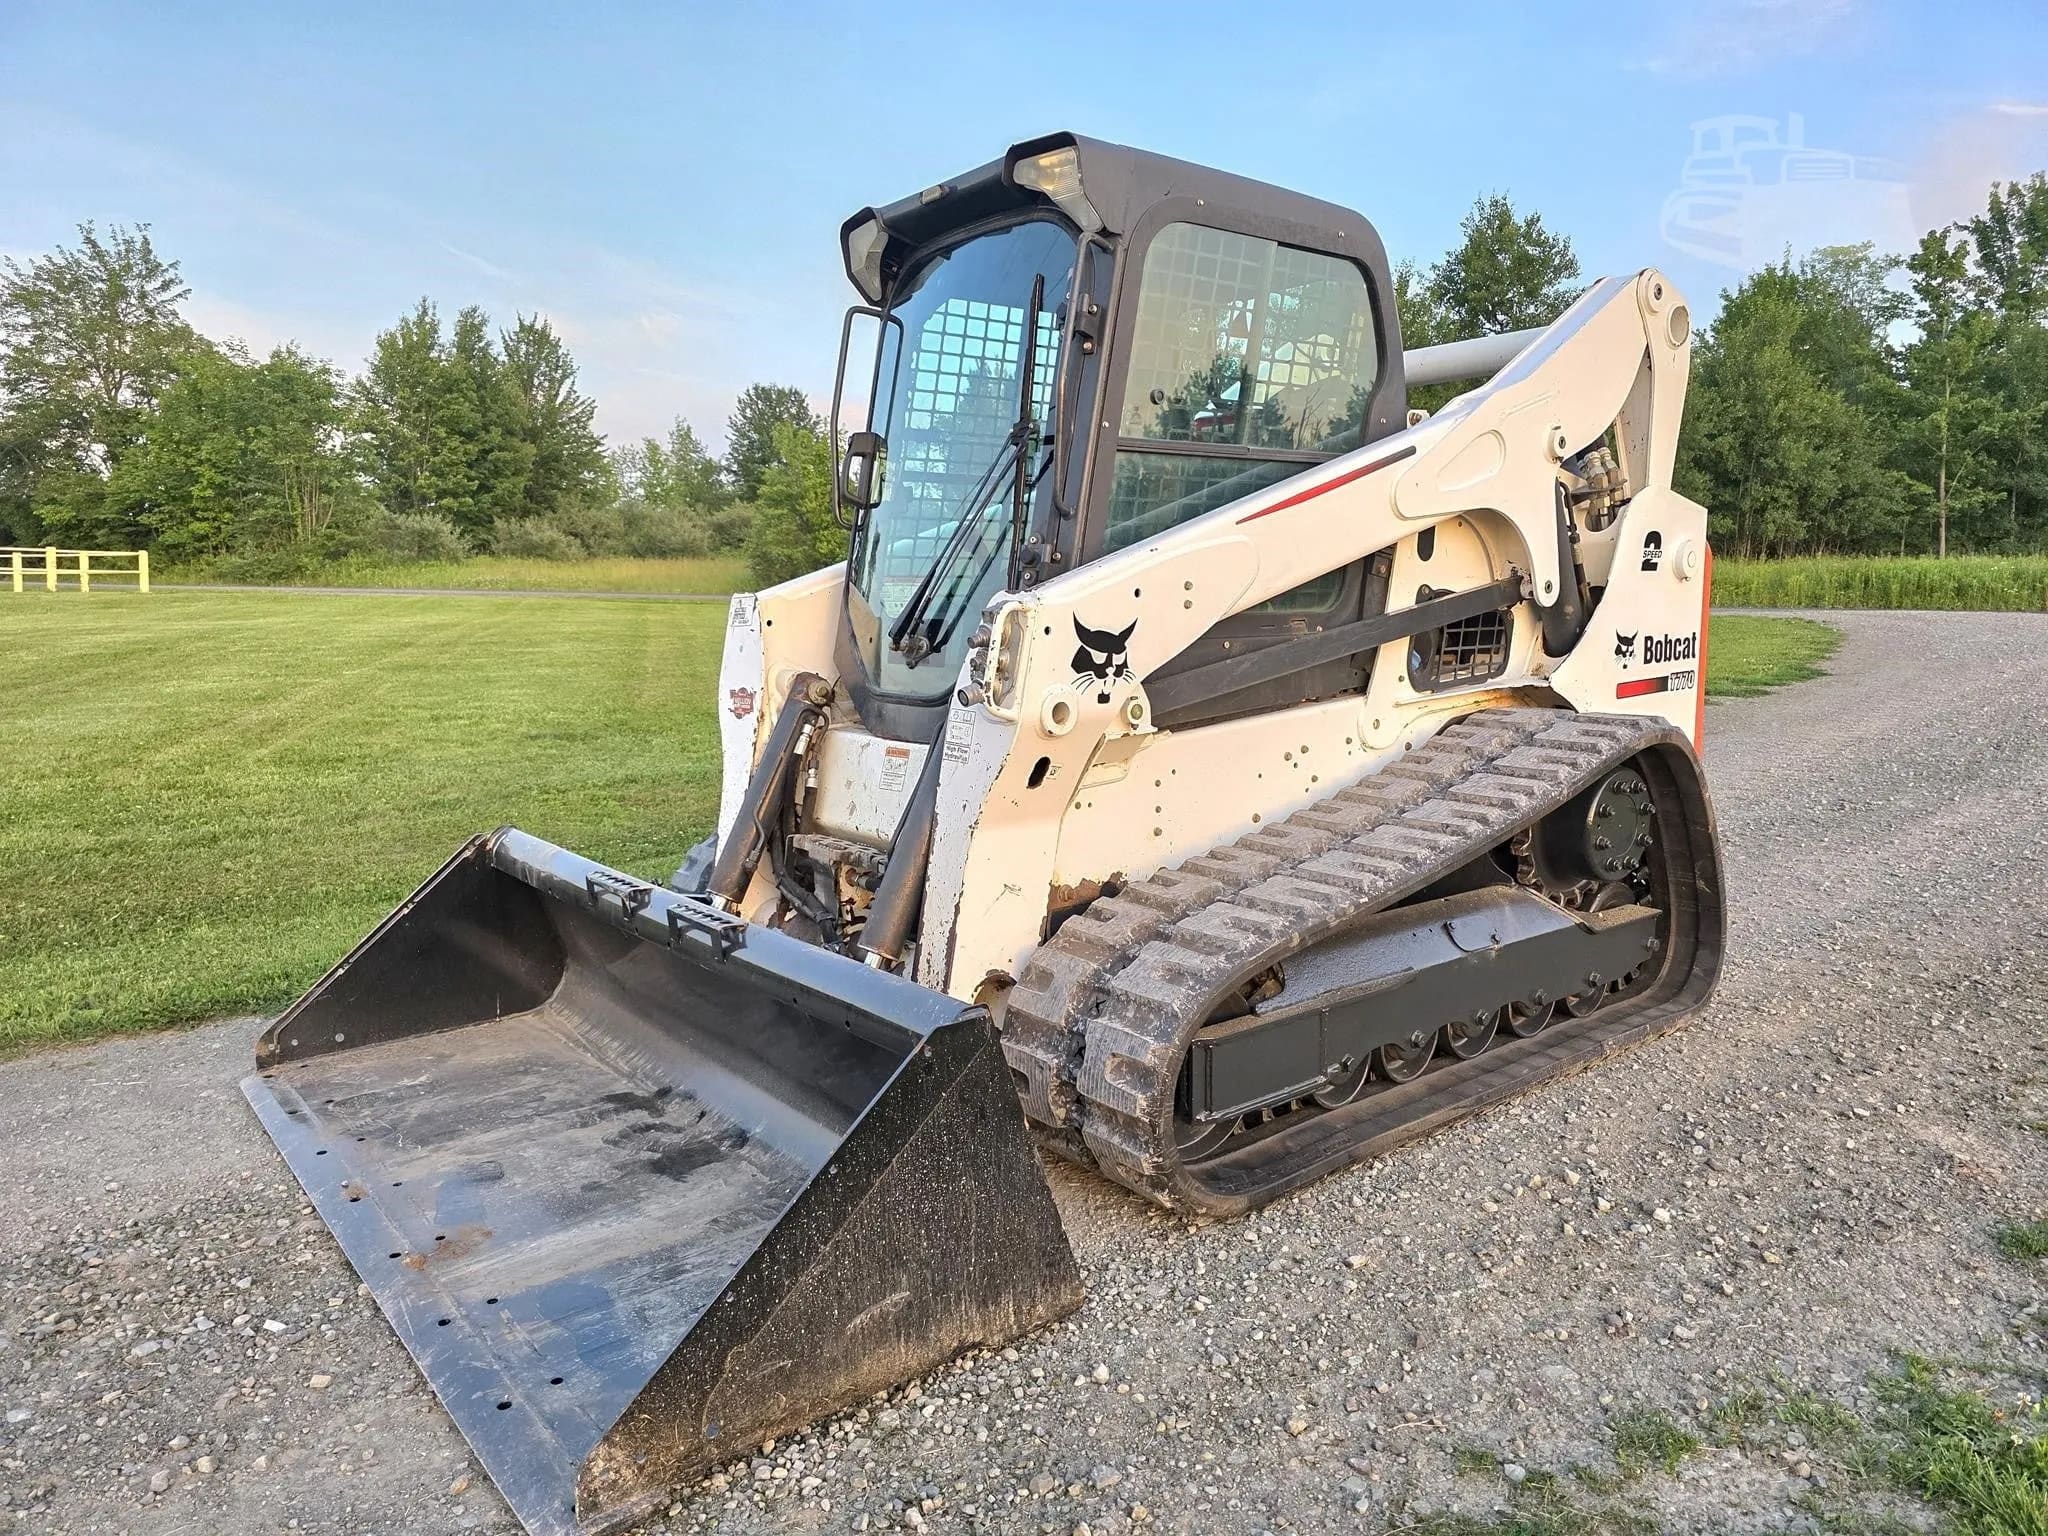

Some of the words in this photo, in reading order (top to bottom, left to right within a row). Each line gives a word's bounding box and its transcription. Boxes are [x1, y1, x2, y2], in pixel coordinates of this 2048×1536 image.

[1641, 530, 1662, 571] 2
[1642, 550, 1663, 559] SPEED
[1643, 631, 1697, 664] Bobcat
[1670, 669, 1696, 691] T770
[946, 745, 957, 753] High
